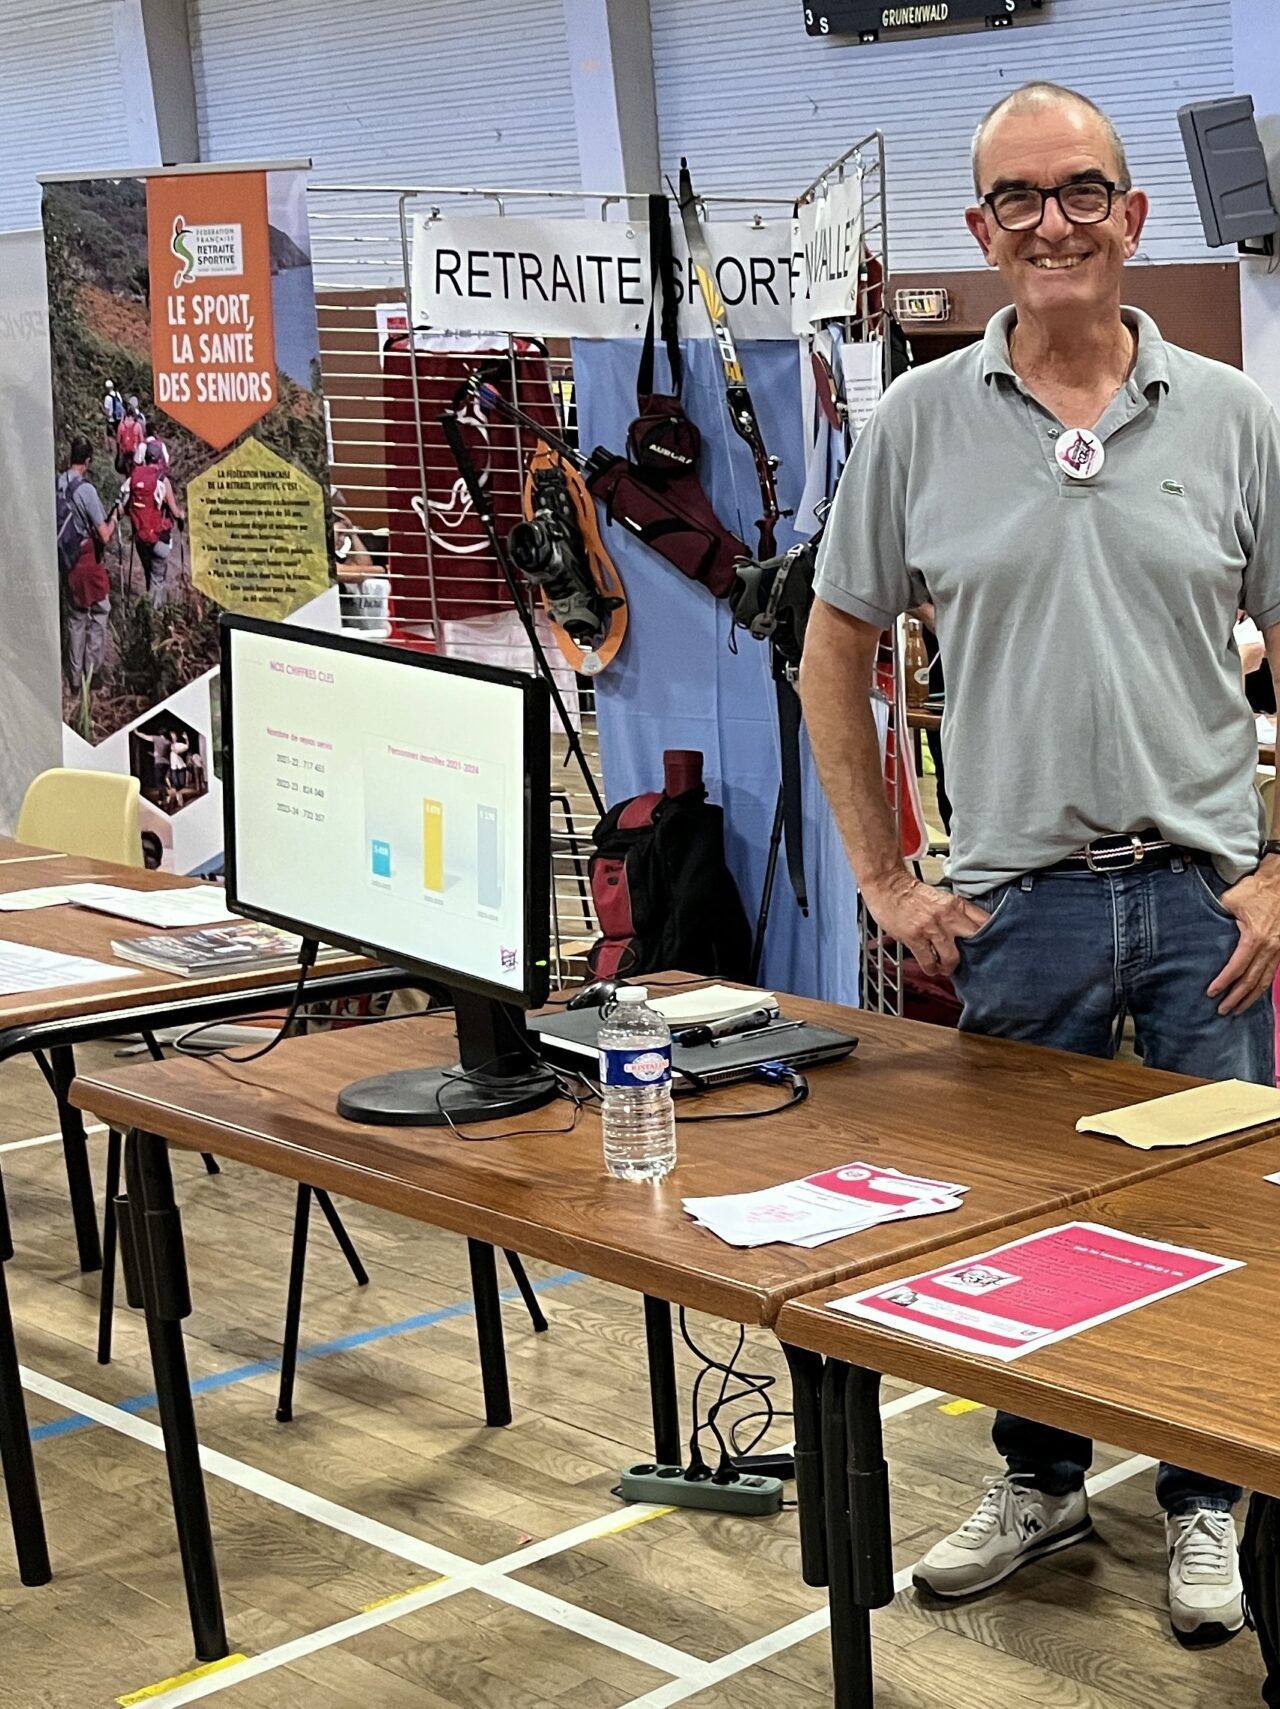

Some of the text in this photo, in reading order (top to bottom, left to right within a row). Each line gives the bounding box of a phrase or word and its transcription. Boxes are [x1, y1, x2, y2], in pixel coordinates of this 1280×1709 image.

[882, 3, 949, 27] GRUNENWALD
[197, 244, 235, 255] RETRAITE
[197, 255, 235, 265] SPORTIVE
[435, 249, 645, 305] RETRAITE
[168, 294, 254, 332] LE SPORT,
[172, 334, 194, 364] LA
[159, 371, 272, 402] DES SENIORS
[207, 481, 215, 490] DE
